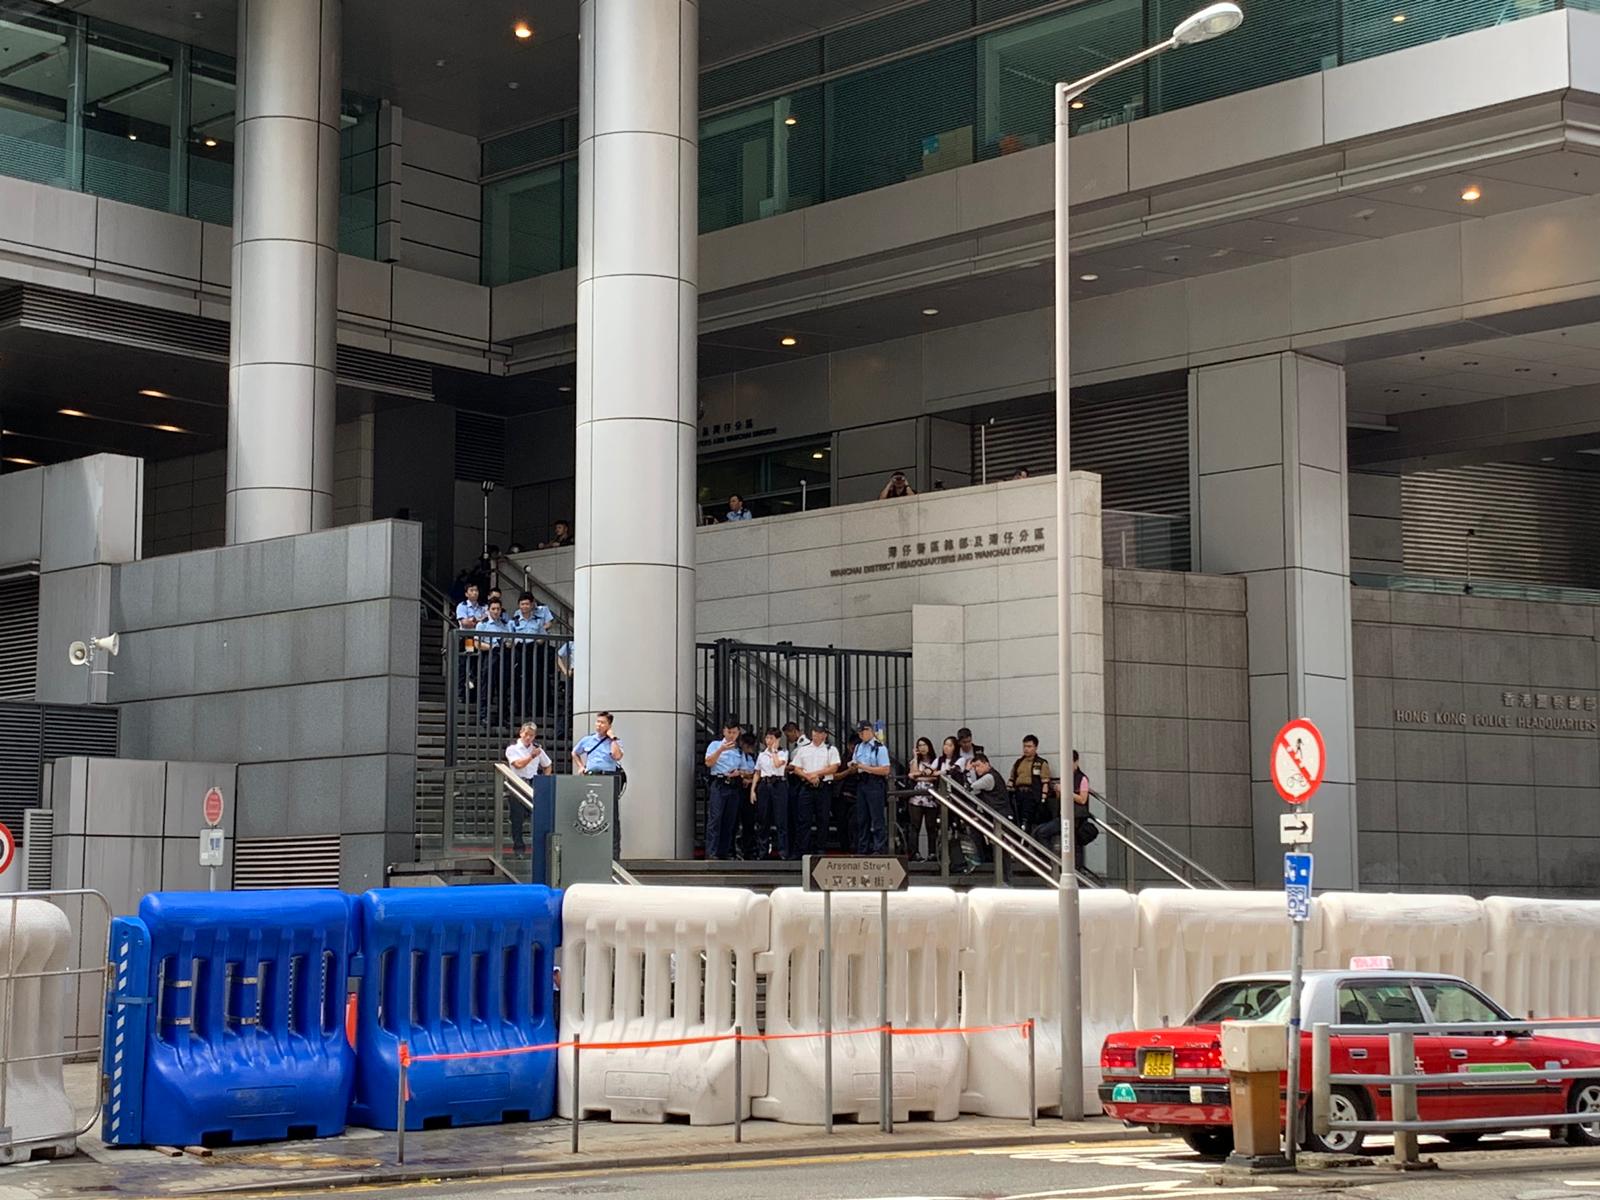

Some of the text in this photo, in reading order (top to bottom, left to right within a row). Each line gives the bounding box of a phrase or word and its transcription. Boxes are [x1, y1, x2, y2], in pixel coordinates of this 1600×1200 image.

[830, 544, 1045, 577] WANCHAI DISTRICT HEADQUARTERS AND WANCHAI DIVISION
[1395, 709, 1598, 732] HONG KONG POLICE HEADQUARTERS
[826, 861, 860, 870] Arsenal
[1353, 957, 1384, 969] TAXI
